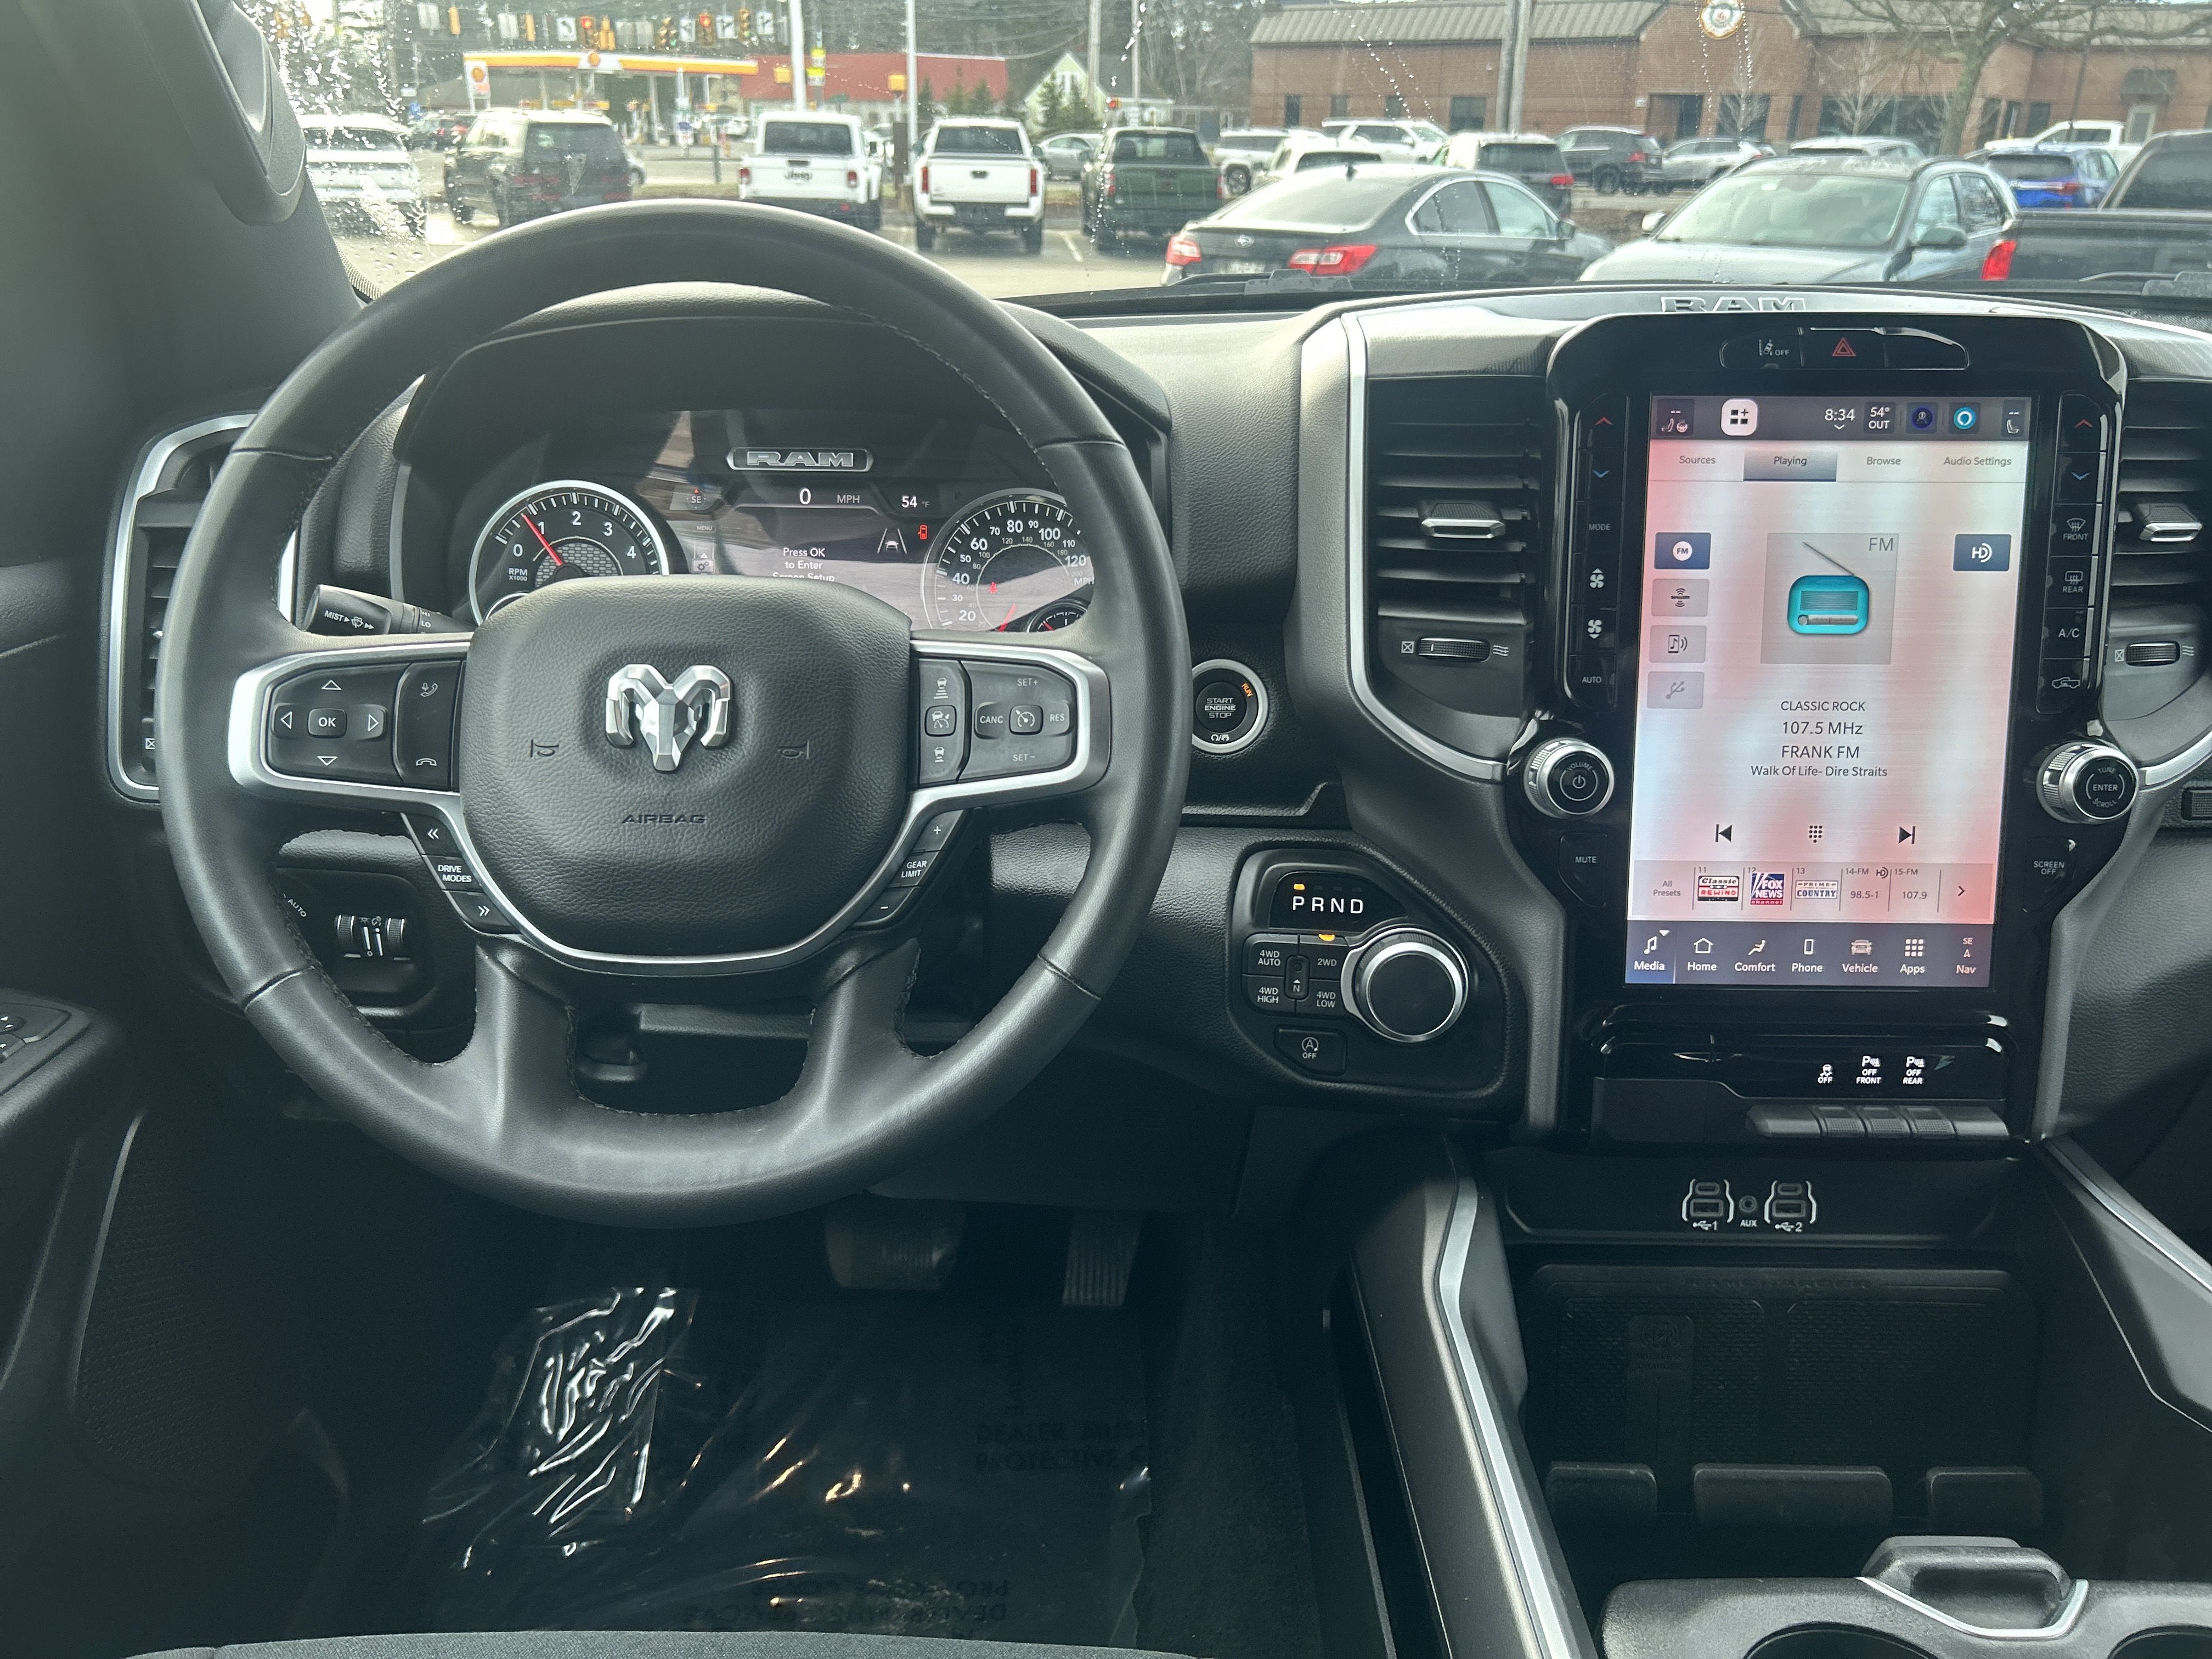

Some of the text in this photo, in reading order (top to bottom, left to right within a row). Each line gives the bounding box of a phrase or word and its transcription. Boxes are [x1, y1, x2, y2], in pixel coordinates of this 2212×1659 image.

[1661, 297, 1805, 312] RAM
[1825, 409, 1855, 422] 8:34
[1870, 407, 1891, 417] 54°
[1869, 420, 1891, 430] OUT
[747, 452, 854, 467] RAM
[1679, 456, 1716, 465] Sources
[1774, 456, 1808, 467] Playing
[1866, 456, 1901, 466] Browse
[1944, 456, 2011, 468] Audio Settings
[799, 488, 860, 505] 0 MPH
[901, 496, 917, 508] 54
[572, 511, 581, 526] 2
[539, 522, 545, 534] 1
[604, 522, 613, 535] 3
[1007, 520, 1023, 533] 80
[1028, 521, 1039, 529] 90
[989, 527, 1001, 535] 70
[1039, 528, 1060, 540] 100
[970, 538, 988, 550] 60
[1869, 538, 1893, 551] FM
[513, 544, 523, 557] 0
[627, 546, 636, 558] 4
[783, 548, 825, 557] Press OK
[960, 555, 971, 563] 50
[1065, 555, 1086, 567] 120
[952, 573, 970, 585] 40
[1074, 577, 1094, 585] MPH
[324, 611, 345, 622] MIST
[959, 611, 976, 621] 20
[2058, 629, 2080, 638] A/C
[1242, 682, 1253, 697] RUN
[1781, 701, 1866, 712] CLASSIC ROCK
[318, 717, 336, 727] OK
[980, 716, 1003, 724] CANC
[1782, 721, 1863, 735] 107.5 MHz
[1781, 746, 1860, 759] FRANK FM
[1567, 762, 1592, 771] VOLUME
[1751, 766, 1888, 776] Walk Of Life- Dire Straits
[2092, 798, 2118, 808] SCROLL
[621, 814, 707, 823] AIRBAG
[438, 865, 461, 873] DRIVE
[901, 870, 922, 878] LIMIT
[1894, 868, 1918, 876] 15-FM
[443, 874, 472, 883] MODES
[1761, 880, 1783, 889] FOX
[1755, 889, 1783, 898] NEWS
[1850, 891, 1879, 899] 98.5-1
[1902, 891, 1927, 900] 107.9
[287, 899, 307, 918] AUTO
[1259, 950, 1280, 958] 4WD
[1257, 958, 1281, 967] AUTO
[1317, 958, 1337, 967] 2WD
[1634, 961, 1665, 971] Media
[1687, 962, 1717, 972] Home
[1734, 962, 1775, 972] Comfort
[1792, 962, 1823, 972] Phone
[1842, 963, 1878, 973] Vehicle
[1899, 964, 1926, 975] Apps
[1956, 964, 1975, 974] Nav
[1259, 987, 1279, 995] 4WD
[1317, 991, 1336, 1000] 4WD
[1257, 995, 1279, 1003] HIGH
[1317, 1000, 1336, 1008] LOW
[1856, 1076, 1882, 1085] FRONT
[1795, 1222, 1802, 1232] 2
